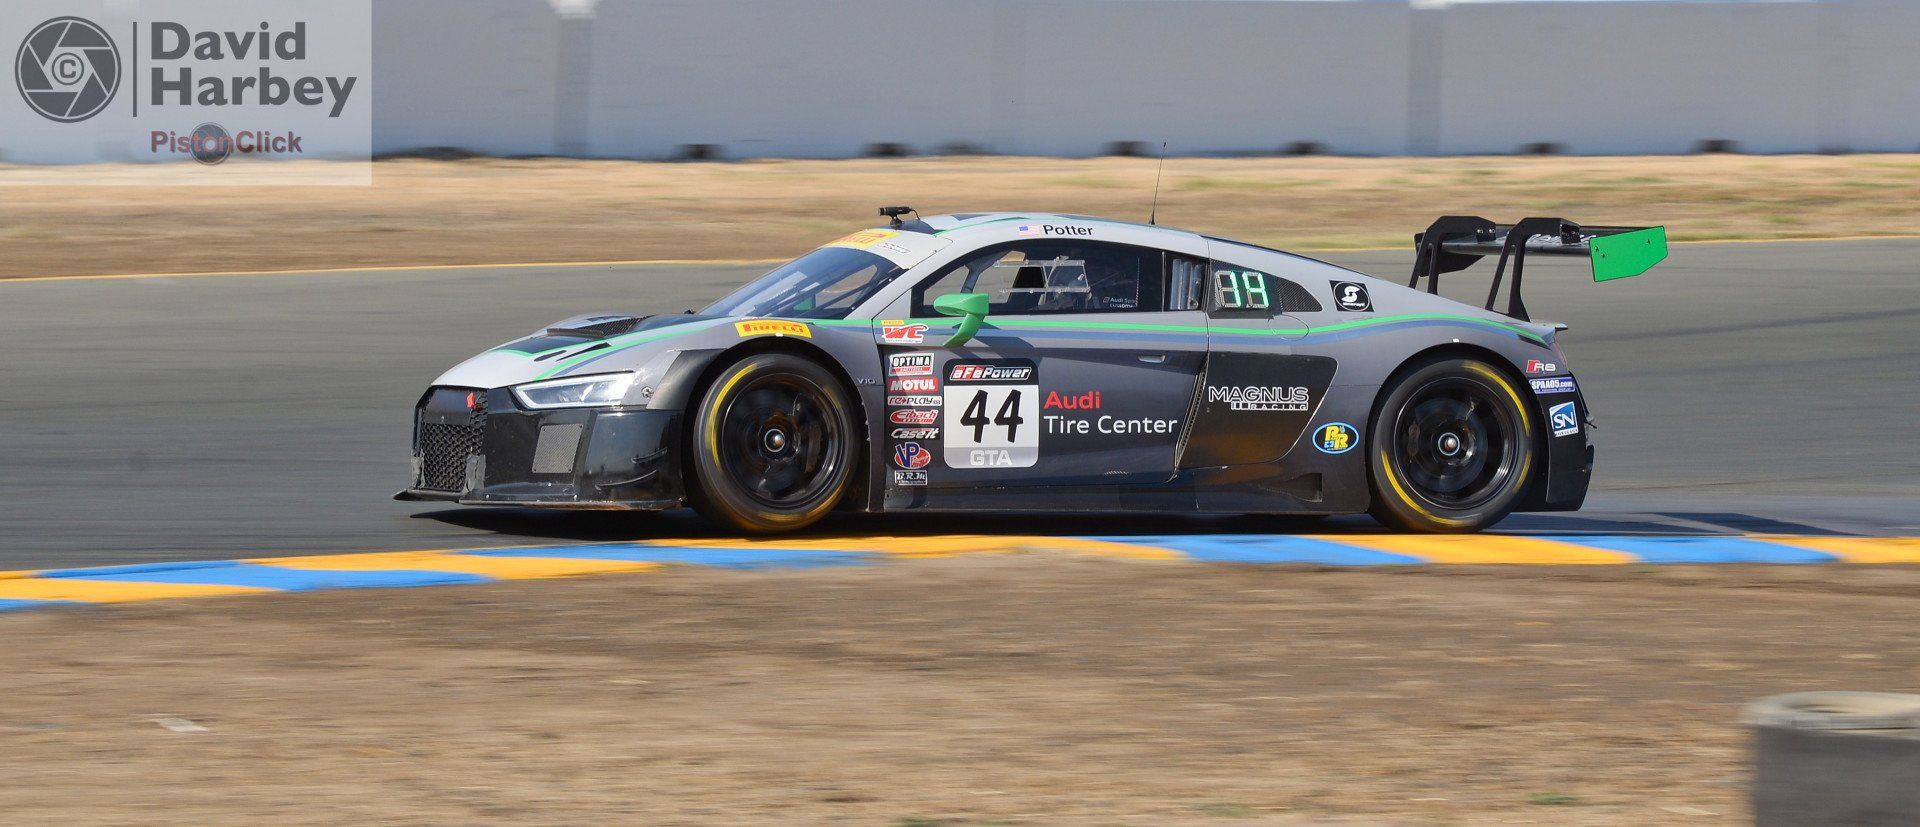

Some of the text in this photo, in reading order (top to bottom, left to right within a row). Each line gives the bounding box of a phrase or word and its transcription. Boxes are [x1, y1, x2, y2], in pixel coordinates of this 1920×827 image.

[1043, 224, 1093, 236] Potter
[884, 325, 928, 339] WC
[893, 357, 930, 367] OPTIMA
[1533, 363, 1556, 372] R8
[891, 380, 936, 391] MOTUL
[1532, 380, 1573, 389] SPAA05.com
[1044, 391, 1101, 409] Audi
[1209, 386, 1309, 402] MAGNUS
[1251, 403, 1308, 411] RACING
[897, 410, 937, 421] Eibach
[960, 389, 1024, 443] 44
[1553, 411, 1575, 429] SN
[1044, 416, 1177, 433] Tire Center
[895, 442, 920, 468] VP
[970, 450, 1012, 466] GTA
